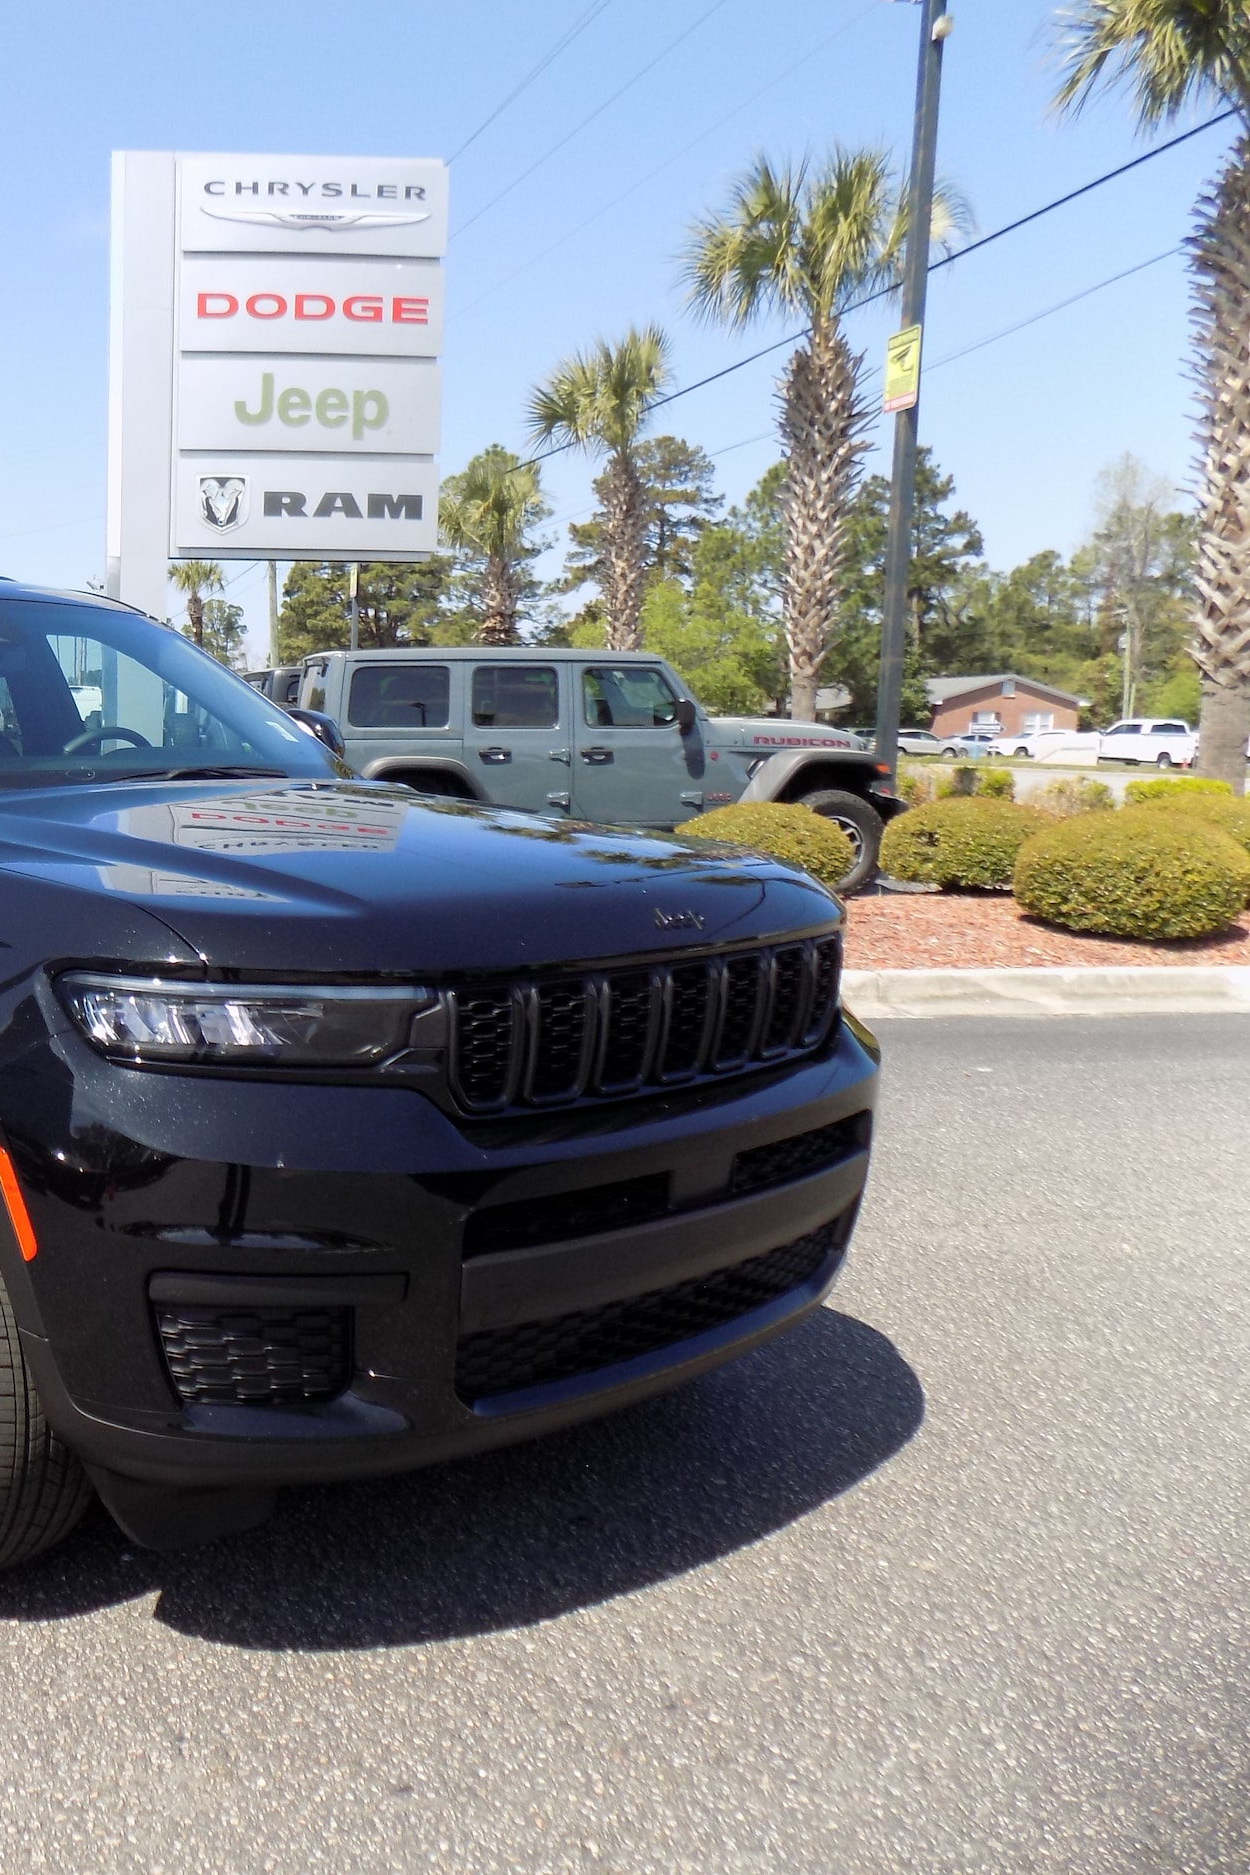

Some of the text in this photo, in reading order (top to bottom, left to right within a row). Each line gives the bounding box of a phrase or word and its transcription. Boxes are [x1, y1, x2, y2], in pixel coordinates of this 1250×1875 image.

[203, 181, 427, 200] CHRYSLER
[197, 292, 429, 324] DODGE
[234, 372, 389, 440] Jeep
[263, 490, 423, 520] RAM
[753, 735, 850, 747] RUBICON
[654, 907, 706, 930] Jeep
